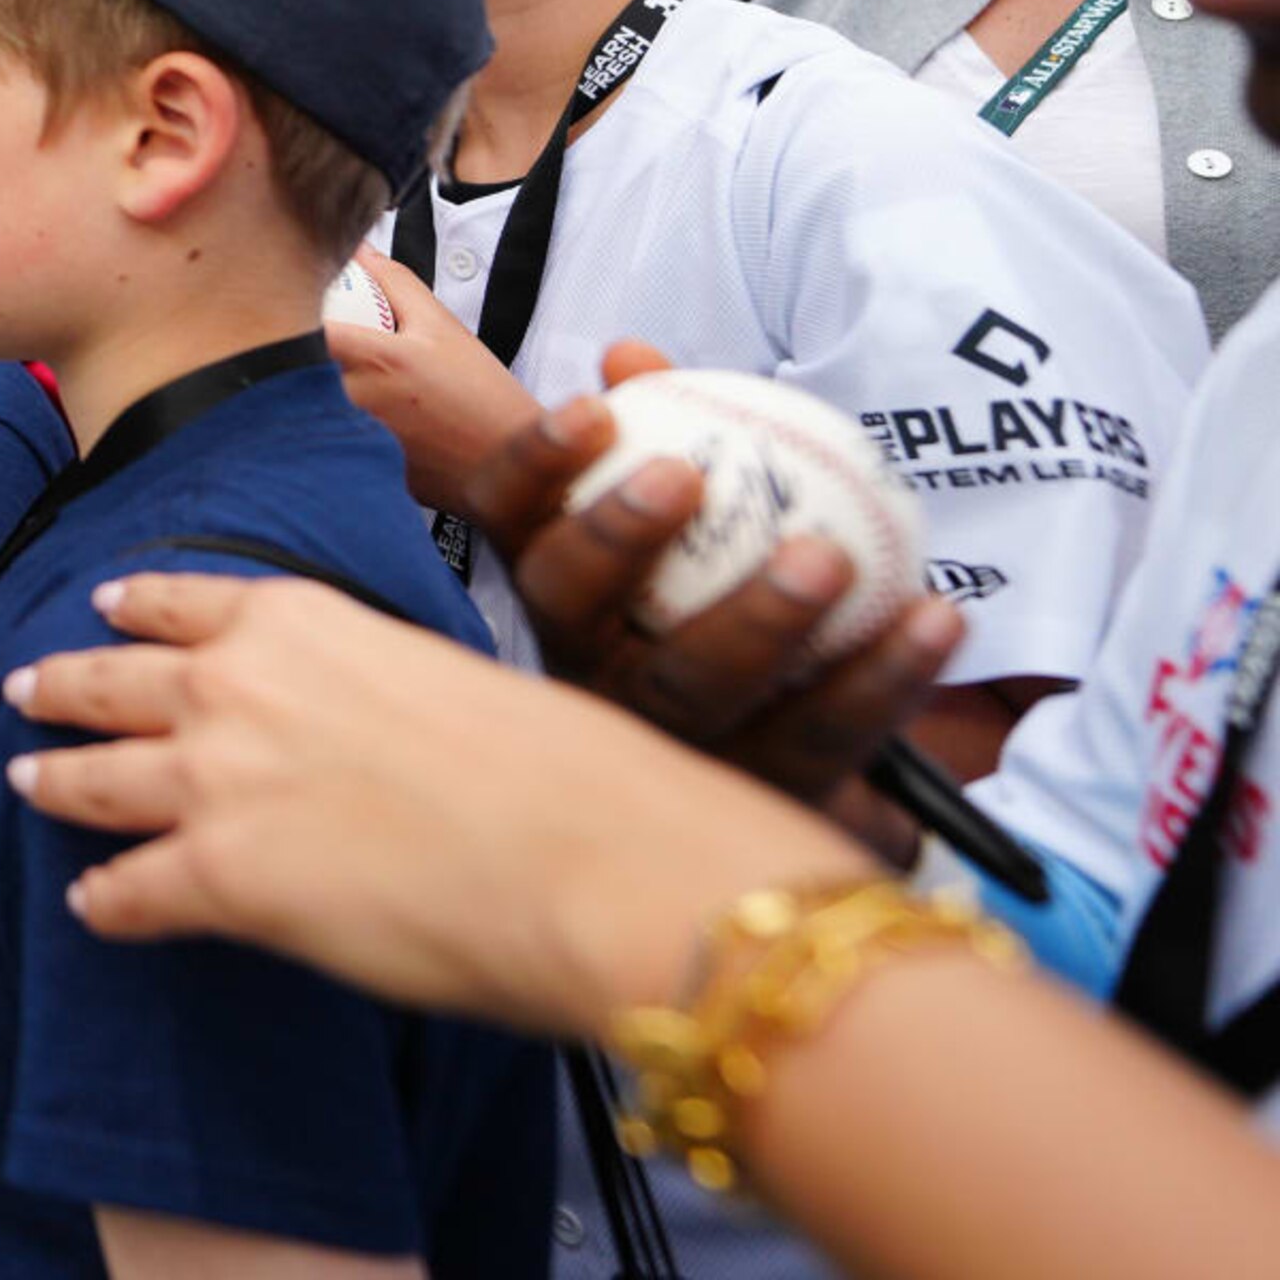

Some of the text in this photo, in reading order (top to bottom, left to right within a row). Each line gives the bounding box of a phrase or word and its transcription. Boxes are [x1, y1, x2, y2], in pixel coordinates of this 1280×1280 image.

[578, 24, 637, 90] LEARN
[584, 34, 653, 100] FRESH
[890, 397, 1149, 469] PLAYERS
